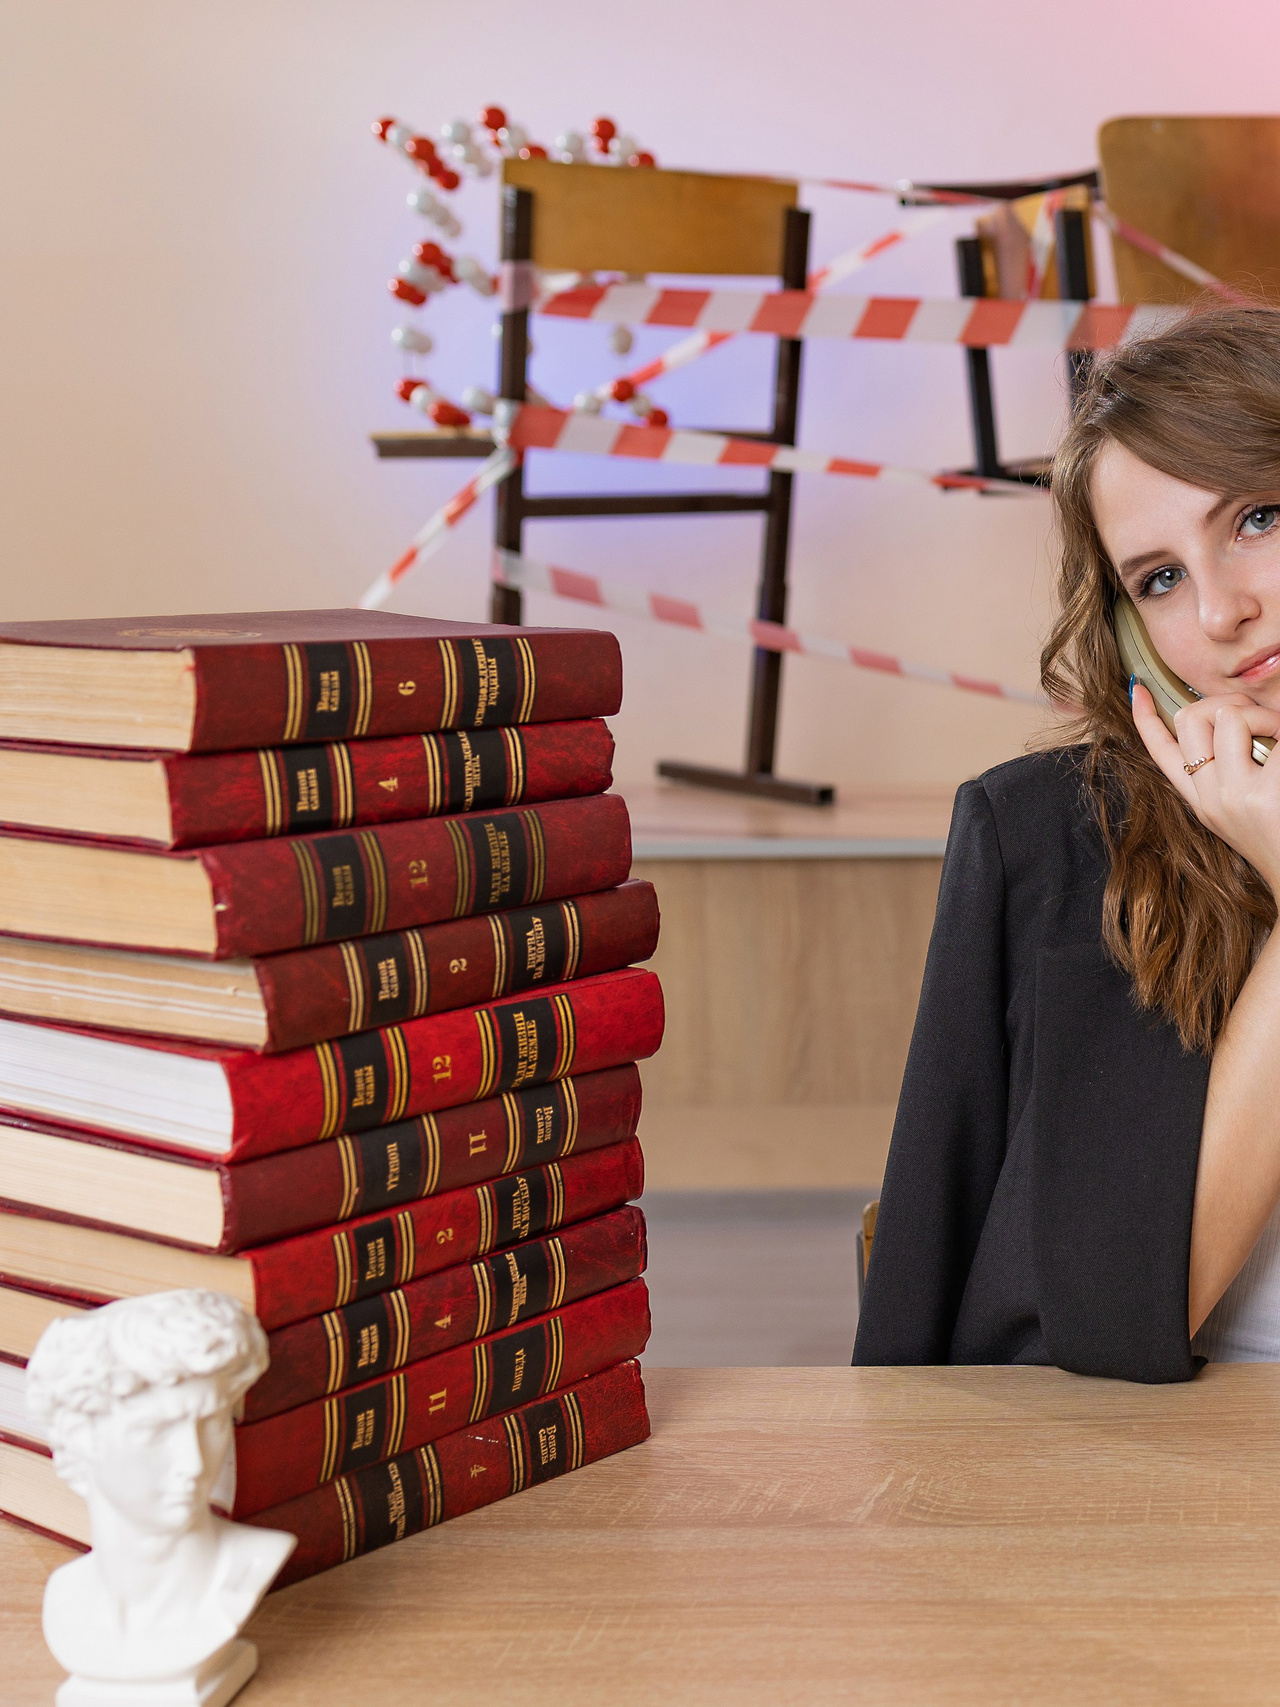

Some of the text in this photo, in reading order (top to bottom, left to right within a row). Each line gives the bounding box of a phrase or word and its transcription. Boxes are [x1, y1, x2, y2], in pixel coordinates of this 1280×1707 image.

[317, 672, 330, 712] Венок
[398, 680, 416, 695] 6
[472, 638, 488, 726] ОСВОБОЖДЕНИЕ
[488, 657, 499, 705] РОДИНЫ
[297, 770, 309, 811] Венок
[378, 777, 398, 792] 4
[409, 859, 428, 889] 12
[484, 822, 501, 903] РАДИ ЖИЗНИ
[498, 831, 510, 892] НА ЗЕМЛЕ
[450, 958, 467, 973] 2
[526, 930, 536, 970] БИТВА
[532, 916, 545, 979] ЗА МОСКВУ
[378, 960, 390, 1001] Венок
[433, 1055, 452, 1083] 12
[511, 1012, 527, 1087] РАДИ ЖИЗНИ
[525, 1020, 538, 1078] НА ЗЕМЛЕ
[352, 1068, 364, 1108] Венок
[536, 1108, 545, 1144] славы
[544, 1106, 553, 1140] Венок
[469, 1130, 487, 1157] 11
[387, 1143, 400, 1191] ПОБЕДА
[512, 1190, 521, 1230] БИТВА
[516, 1177, 530, 1239] ЗА МОСКВУ
[437, 1228, 453, 1244] 2
[366, 1242, 376, 1281] Венок
[434, 1315, 451, 1329] 4
[358, 1327, 369, 1368] Венок
[512, 1348, 526, 1392] ПОБЕДА
[429, 1388, 447, 1415] 11
[352, 1412, 365, 1450] Венок
[539, 1429, 548, 1465] славы
[546, 1425, 557, 1461] Венок
[470, 1464, 487, 1479] 4
